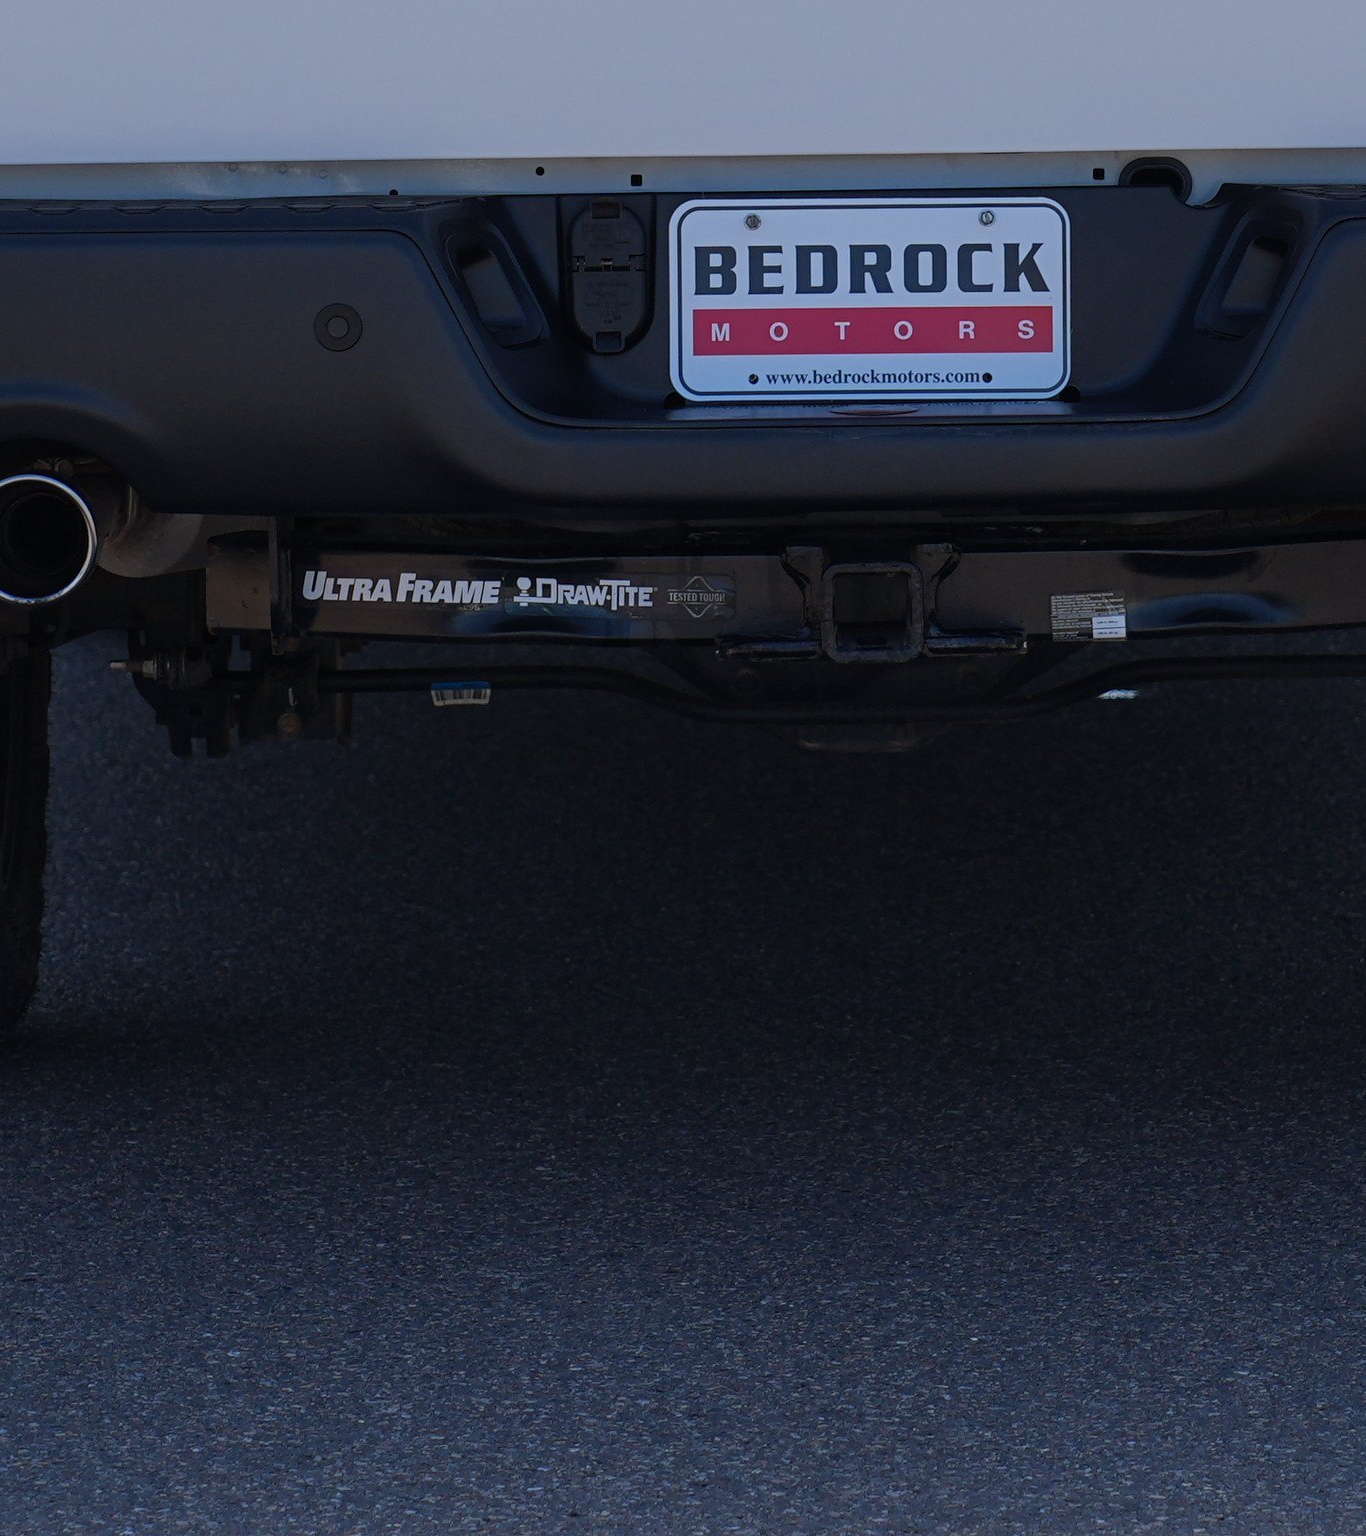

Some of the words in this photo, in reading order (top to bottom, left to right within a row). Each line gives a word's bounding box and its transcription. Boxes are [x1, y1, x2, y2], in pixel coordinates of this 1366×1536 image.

[693, 242, 1051, 296] BEDROCK
[710, 319, 1036, 343] MOTORS
[765, 369, 981, 386] www.bedrockmotors.com
[302, 570, 392, 602] ULTRA
[396, 572, 502, 604] FRAME
[668, 592, 698, 602] TESTED
